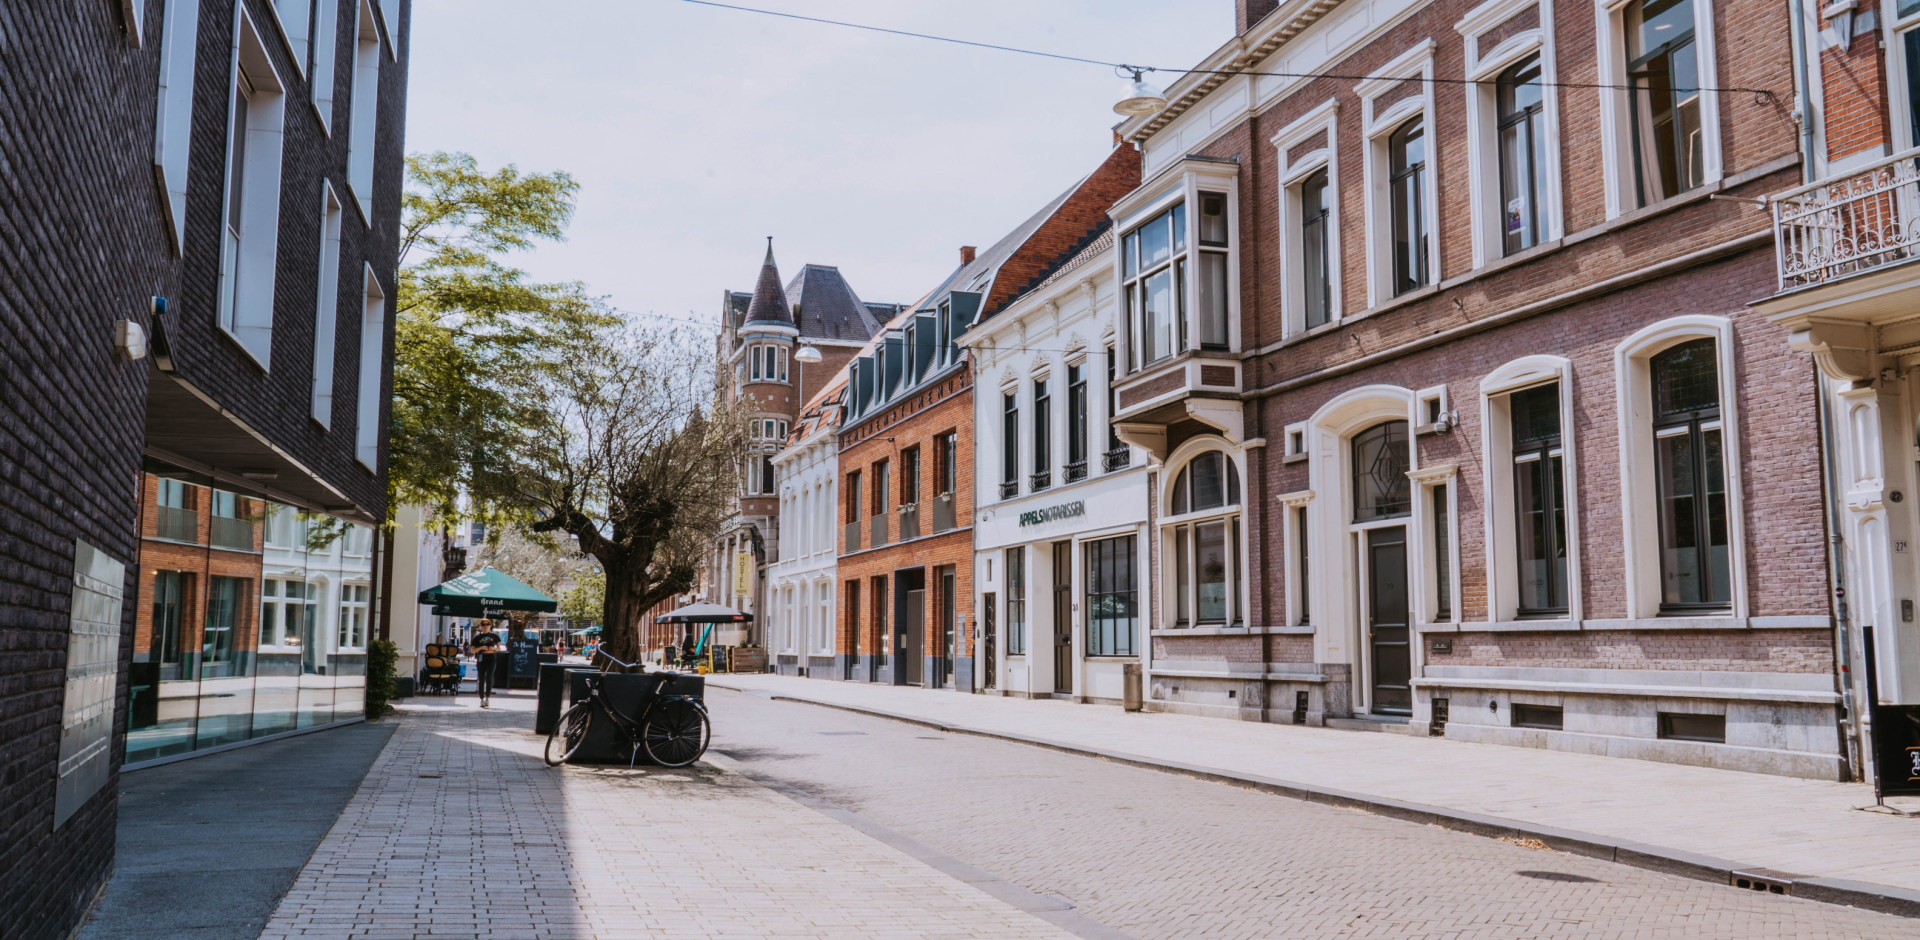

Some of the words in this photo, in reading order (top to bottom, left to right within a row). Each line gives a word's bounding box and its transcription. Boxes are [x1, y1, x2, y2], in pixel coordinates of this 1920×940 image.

[1891, 492, 1900, 501] 27
[1019, 500, 1085, 527] APPELSNOTARISSEN
[480, 597, 504, 606] Brand
